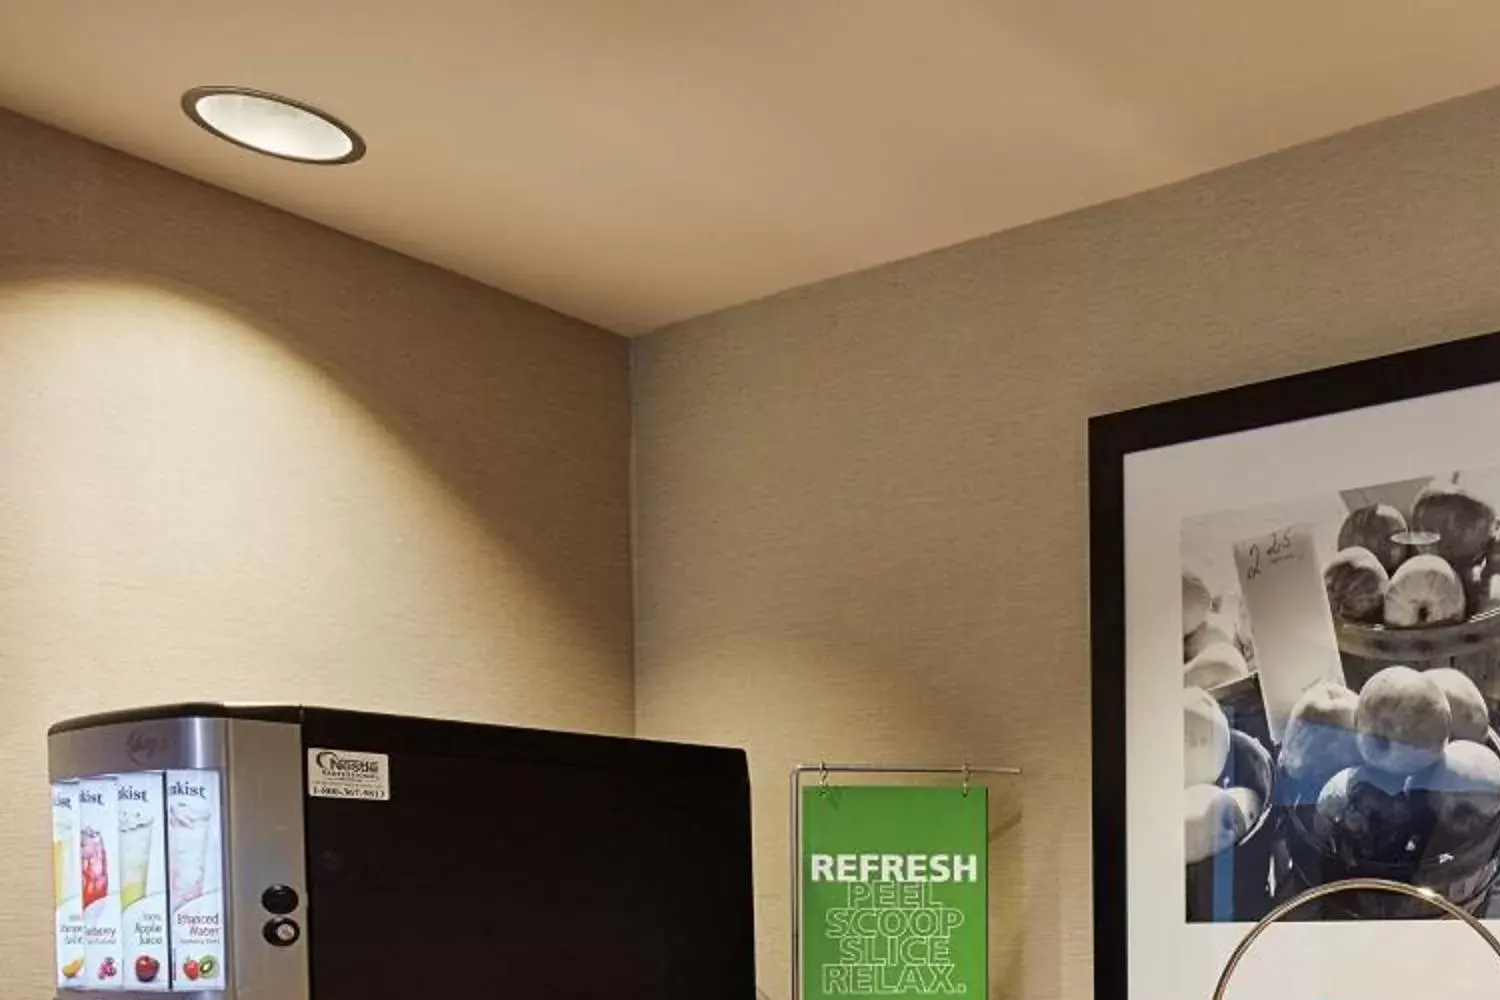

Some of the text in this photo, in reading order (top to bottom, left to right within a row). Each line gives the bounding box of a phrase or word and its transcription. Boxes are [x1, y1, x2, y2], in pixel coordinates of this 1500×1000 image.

[811, 853, 978, 883] REFRESH
[847, 880, 943, 909] PEEL
[825, 907, 965, 938] SCOOP
[839, 937, 952, 966] SLICE
[822, 963, 967, 994] RELAX.
